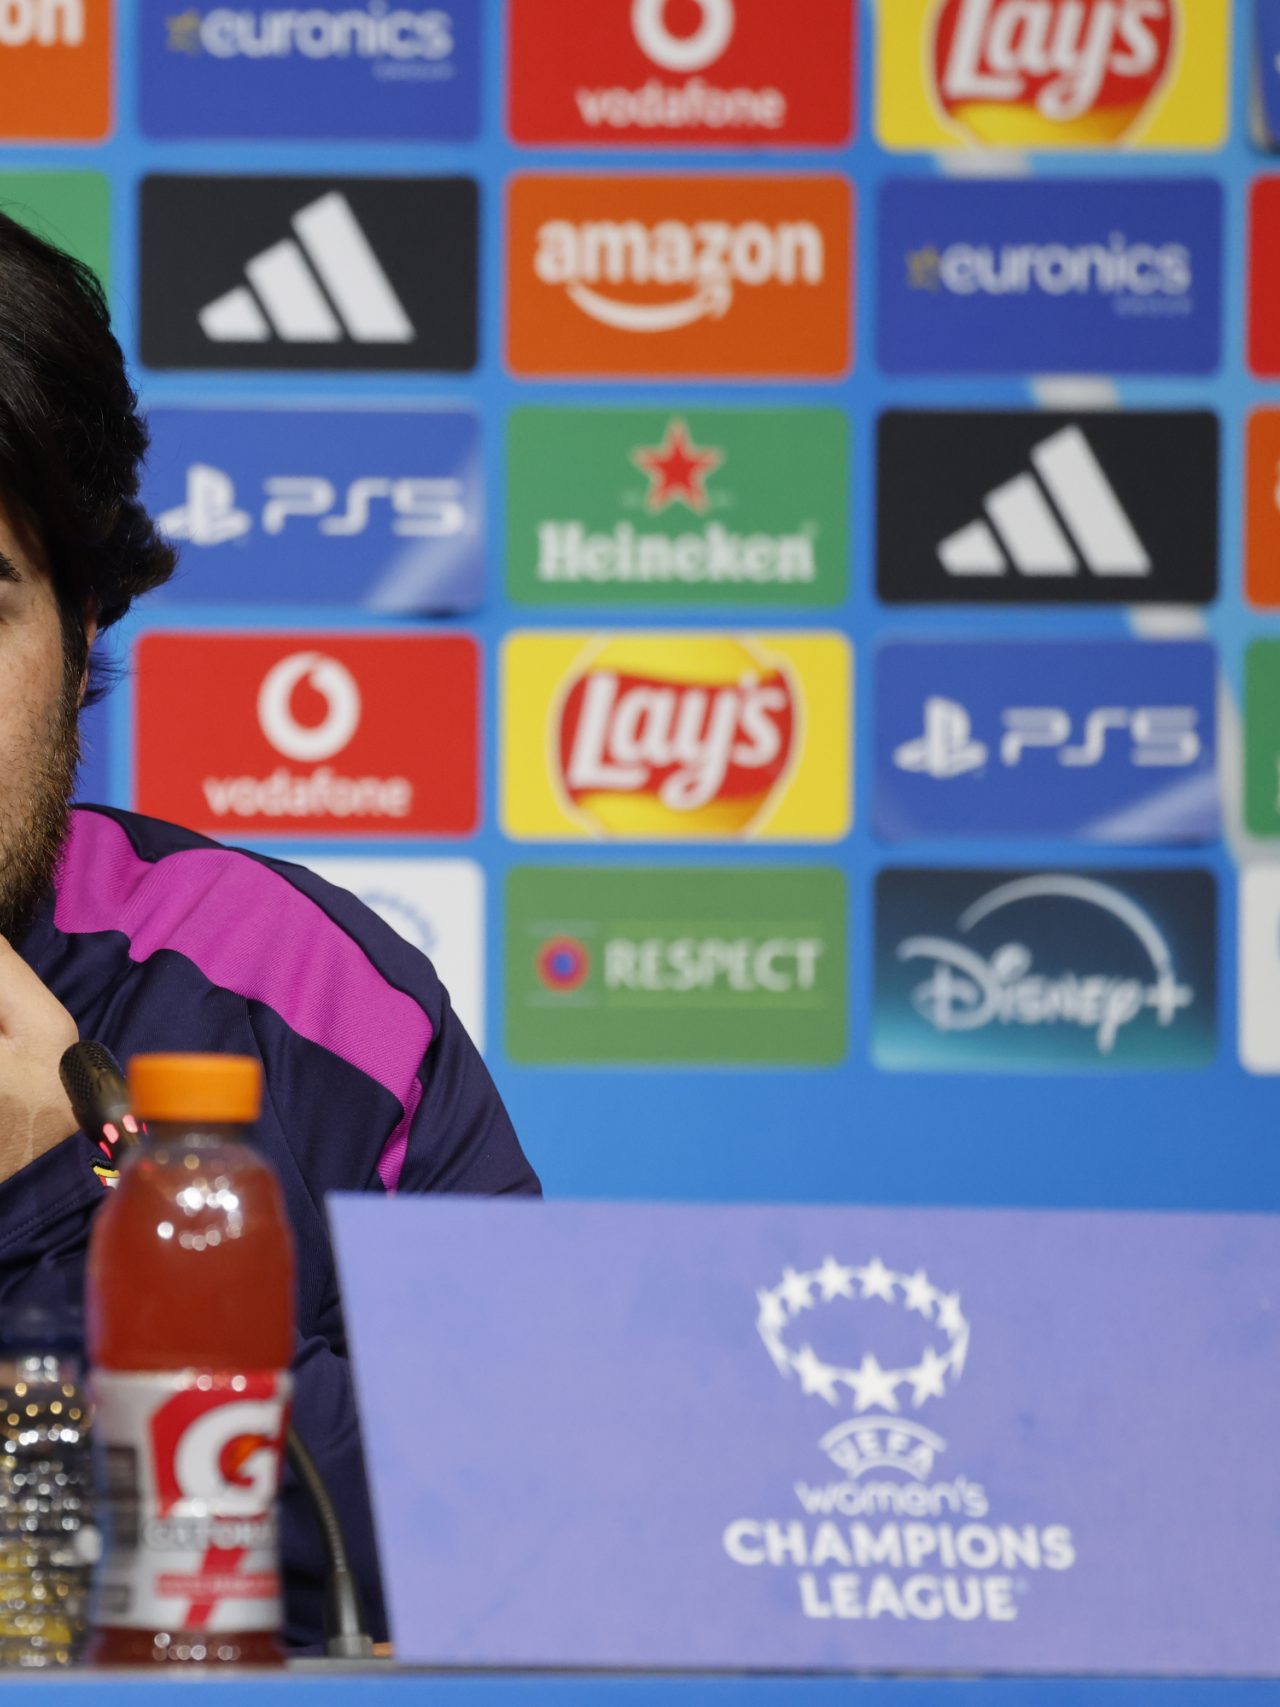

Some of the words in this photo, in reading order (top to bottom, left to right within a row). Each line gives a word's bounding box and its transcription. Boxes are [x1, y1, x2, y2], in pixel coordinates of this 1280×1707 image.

[198, 0, 454, 60] euronics
[942, 0, 1167, 122] Lays
[575, 77, 786, 129] vodafone
[534, 220, 823, 286] amazon
[938, 231, 1192, 295] euronics
[263, 477, 465, 537] PS5
[537, 519, 816, 582] Heineken
[567, 670, 787, 811] Lay's
[1000, 706, 1201, 767] PS5
[203, 767, 413, 817] vodafone
[604, 938, 822, 992] RESPECT
[828, 1430, 934, 1478] UEFA
[794, 1474, 990, 1518] women's
[723, 1518, 1076, 1570] CHAMPIONS
[799, 1572, 1018, 1621] LEAGUE
